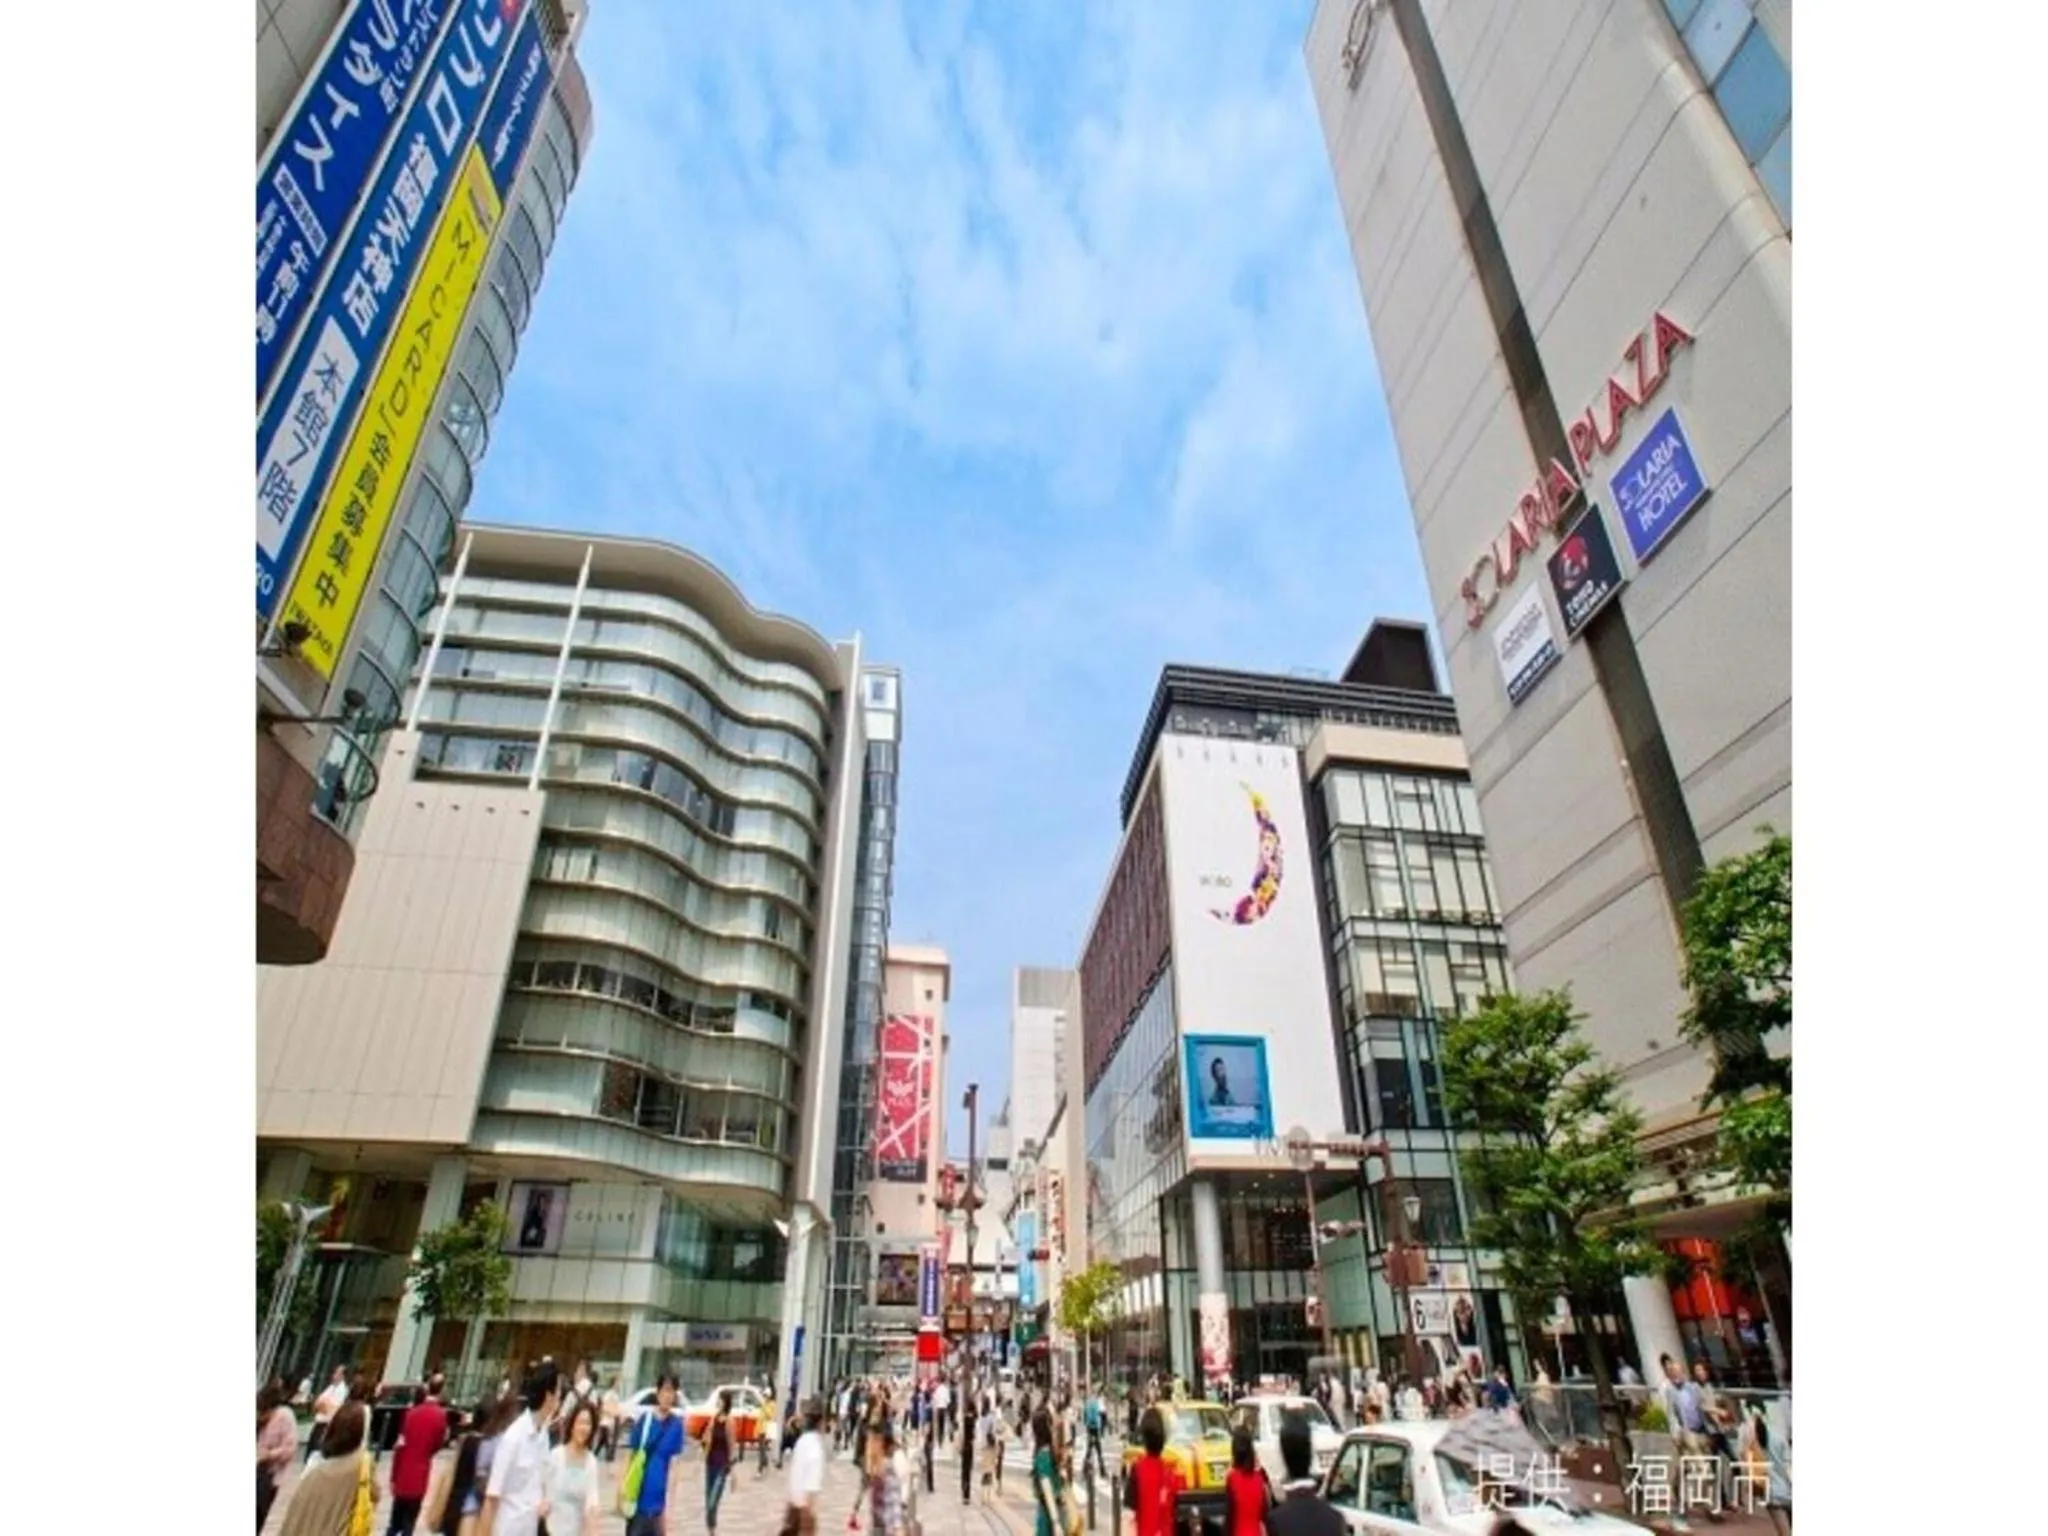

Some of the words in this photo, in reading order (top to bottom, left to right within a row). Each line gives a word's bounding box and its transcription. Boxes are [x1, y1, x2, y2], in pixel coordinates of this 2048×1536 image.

[1461, 457, 1582, 630] SOLARIA
[1569, 311, 1697, 478] PLAZA
[1619, 432, 1683, 513] SOLARIA
[1638, 471, 1688, 532] HOTEL
[1414, 1299, 1426, 1330] 6
